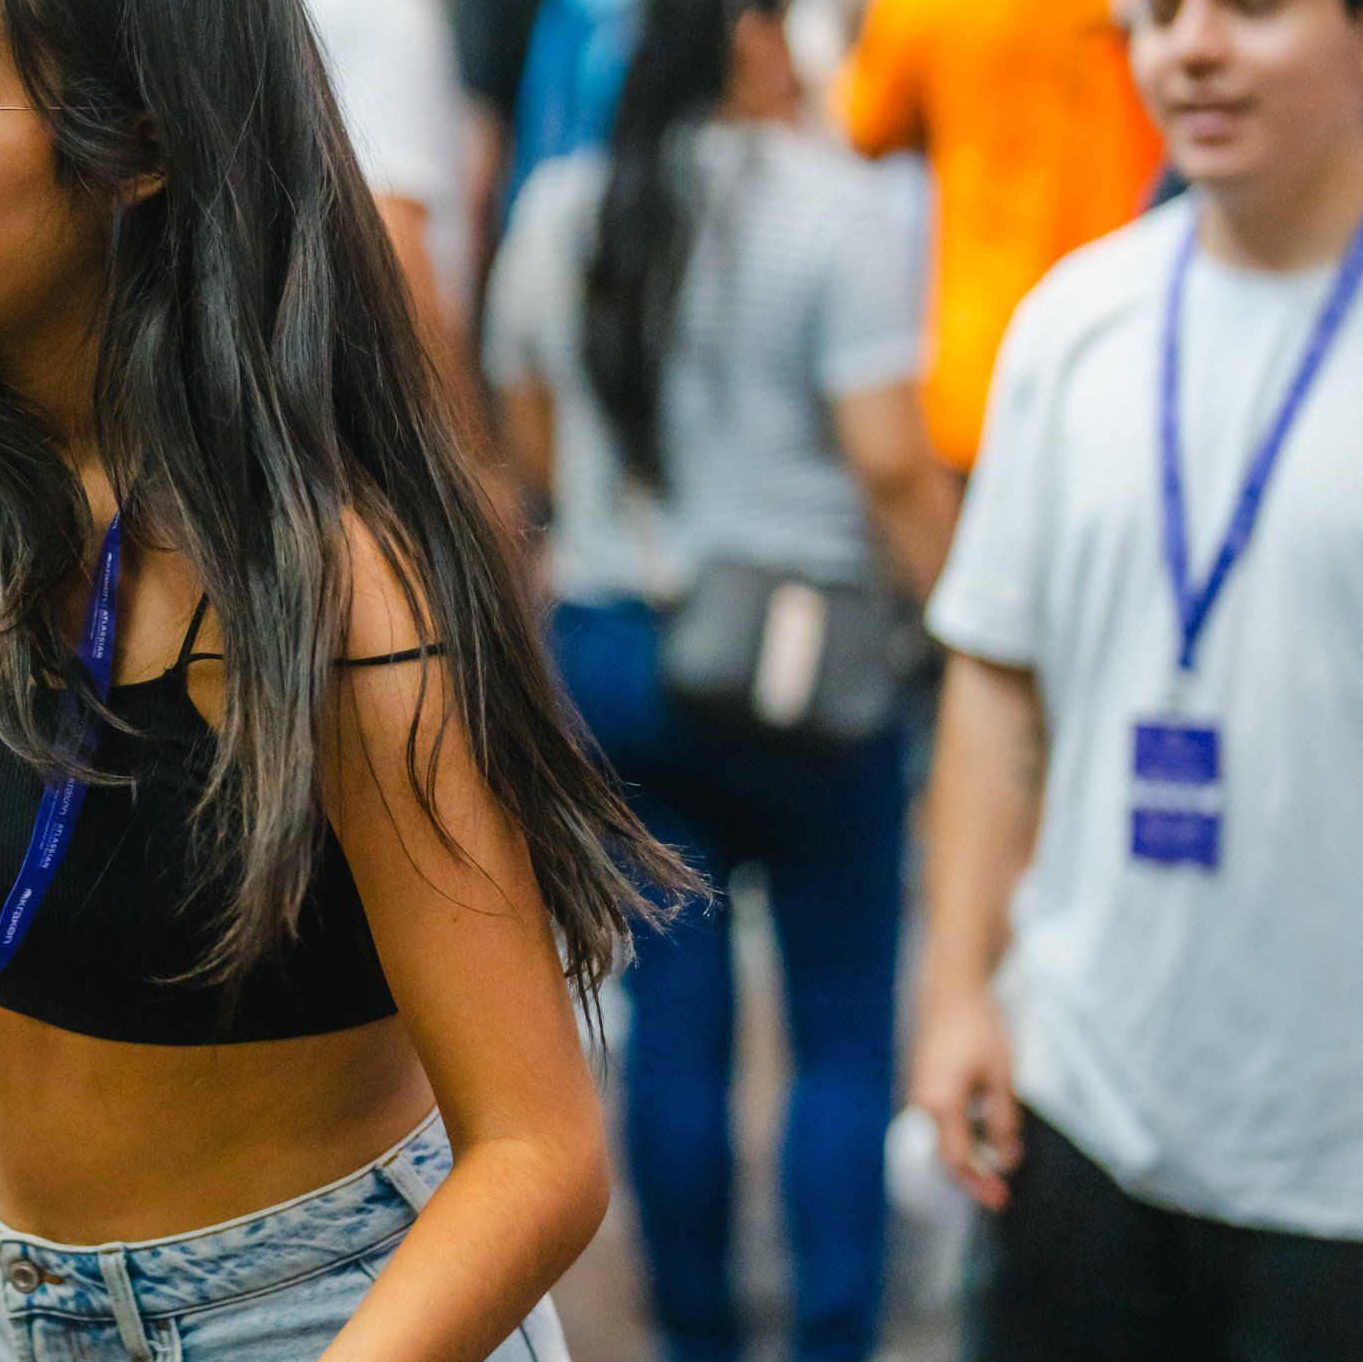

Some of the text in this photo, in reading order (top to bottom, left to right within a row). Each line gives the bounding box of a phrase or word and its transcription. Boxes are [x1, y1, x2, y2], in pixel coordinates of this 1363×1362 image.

[96, 610, 109, 658] ATLASSIAN
[59, 777, 76, 815] kraken
[42, 823, 64, 869] ATLASSIAN
[3, 899, 27, 944] kraken
